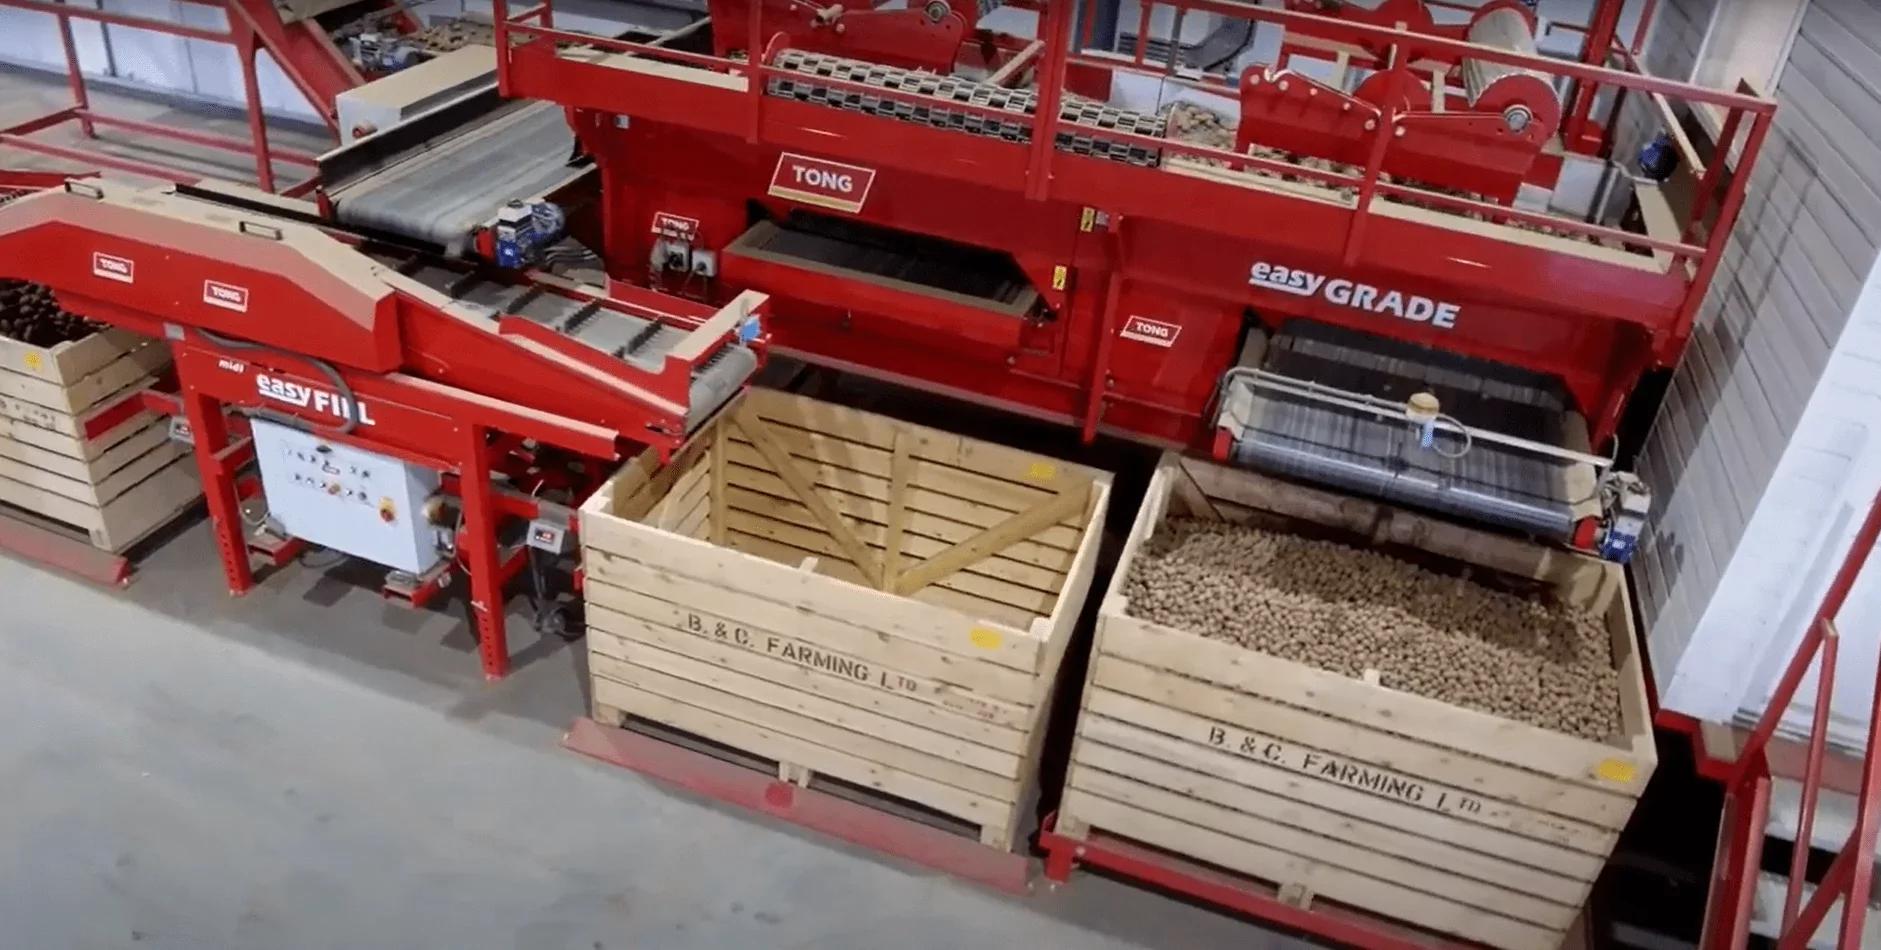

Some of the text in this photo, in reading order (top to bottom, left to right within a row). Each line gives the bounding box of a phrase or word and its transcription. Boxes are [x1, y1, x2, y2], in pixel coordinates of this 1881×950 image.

[792, 165, 853, 193] TONG
[1249, 261, 1461, 329] easyGRADE
[1136, 321, 1169, 338] TONG
[218, 359, 245, 373] midi
[688, 613, 708, 635] B.
[714, 621, 729, 640] &
[734, 627, 755, 648] C.
[767, 636, 869, 682] FARMING
[1208, 726, 1231, 748] B.
[1240, 735, 1257, 753] &
[1263, 742, 1286, 765] C.
[1303, 753, 1424, 803] FARMING
